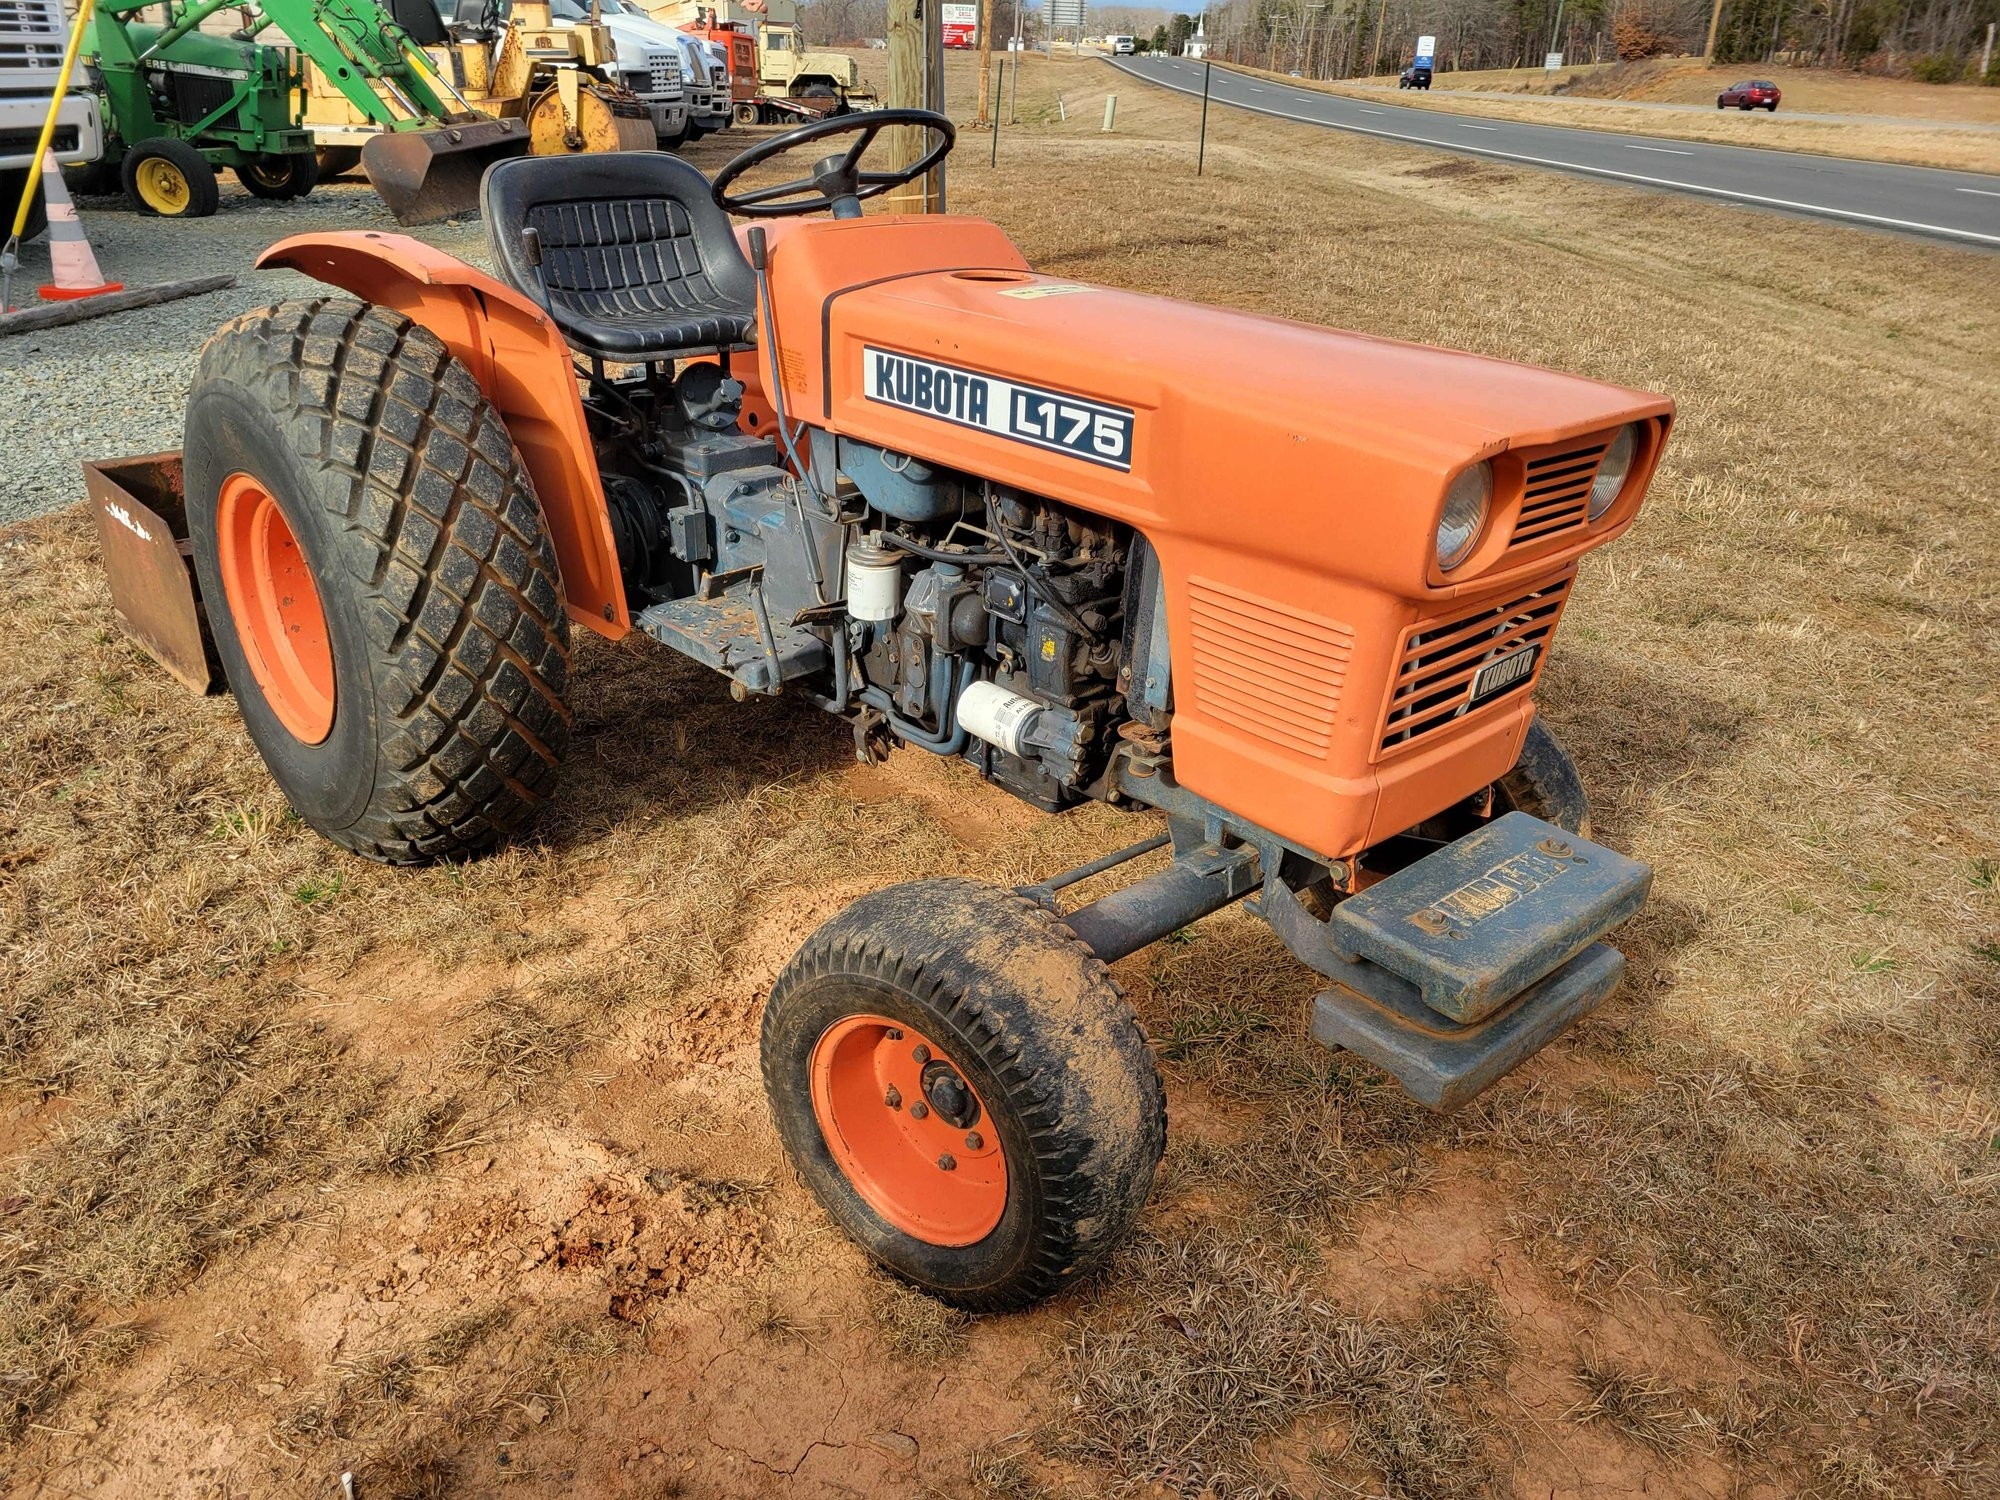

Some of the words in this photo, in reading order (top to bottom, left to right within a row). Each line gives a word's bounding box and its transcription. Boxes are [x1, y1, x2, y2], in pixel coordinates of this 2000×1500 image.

[145, 59, 167, 70] ERE
[875, 353, 989, 427] KUBOTA
[1016, 394, 1124, 457] L175
[1479, 648, 1535, 696] KUBOTA
